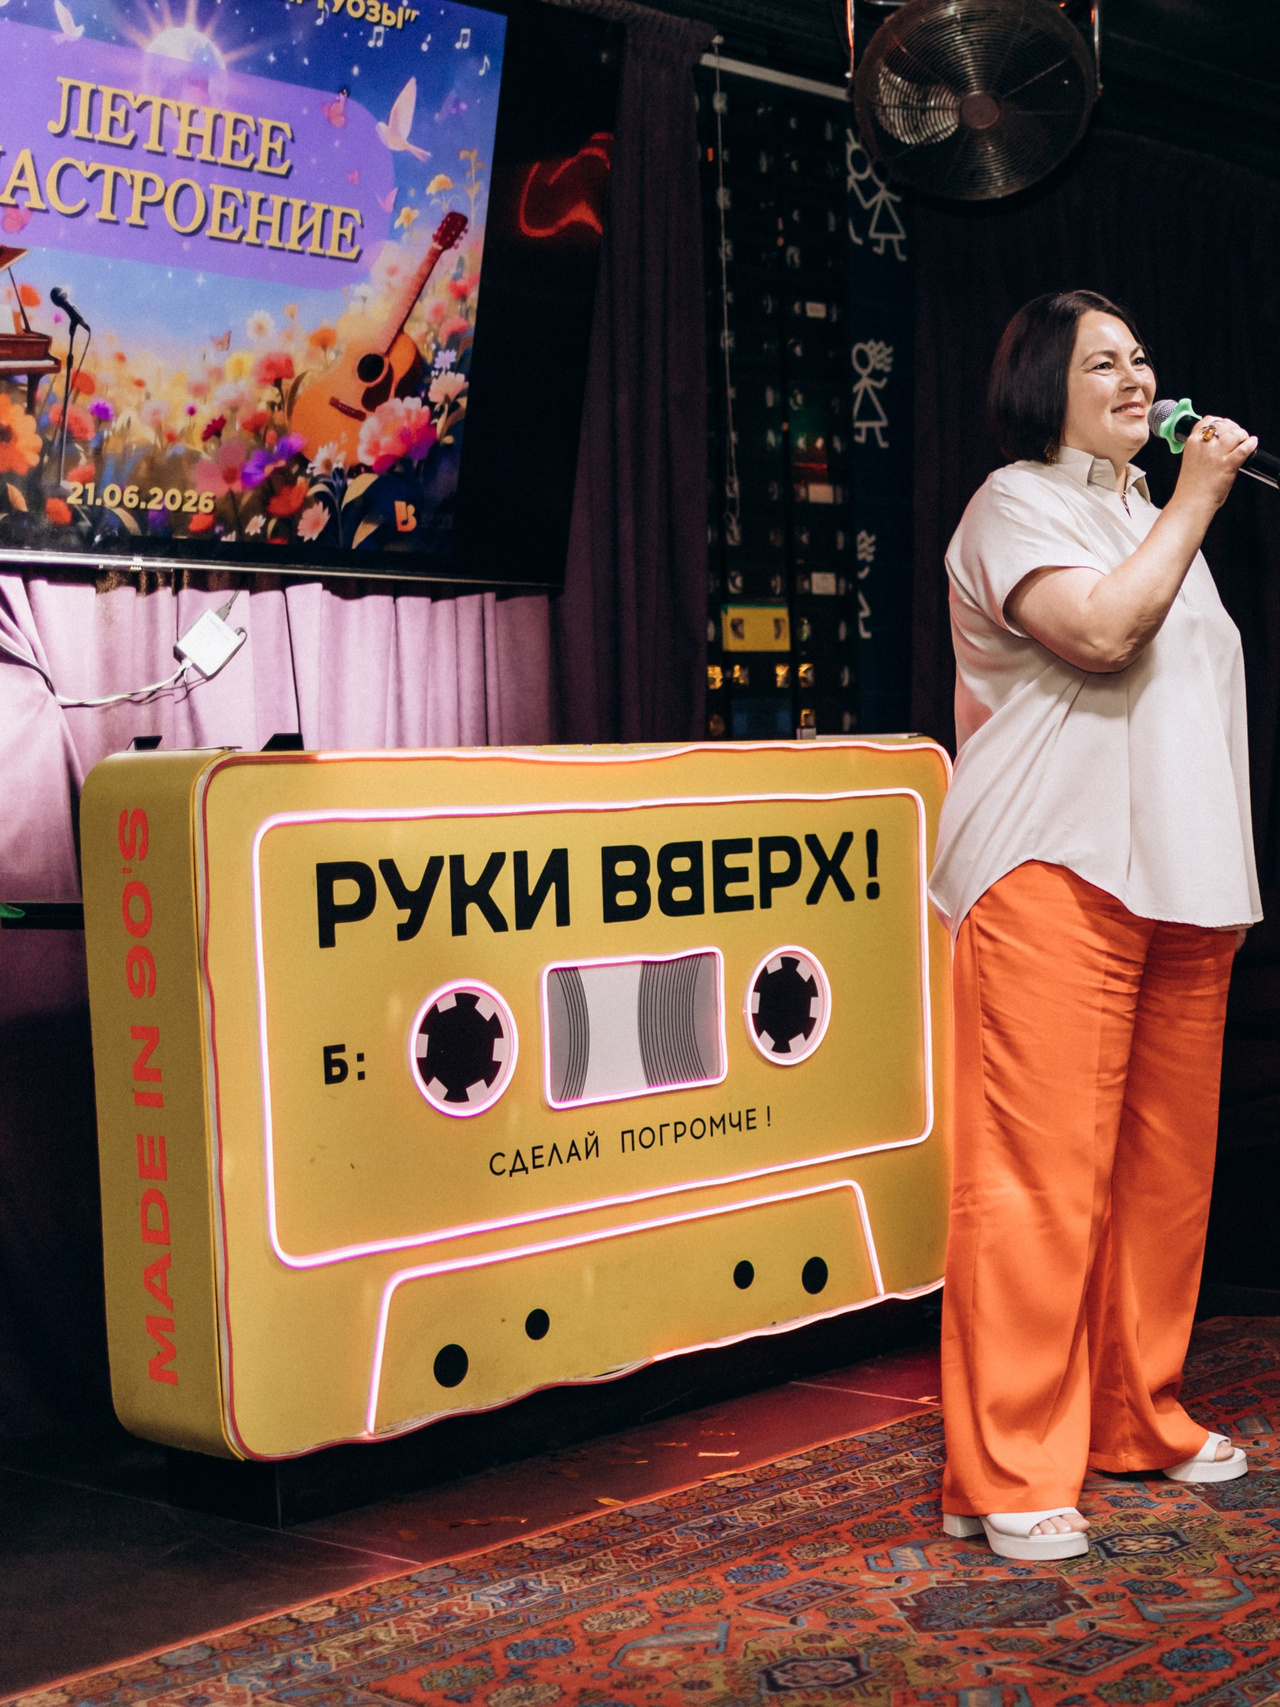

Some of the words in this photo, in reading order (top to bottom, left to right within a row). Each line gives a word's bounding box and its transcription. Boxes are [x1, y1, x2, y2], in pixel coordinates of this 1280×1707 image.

[47, 75, 294, 177] ЛЕТНЕЕ
[0, 145, 364, 261] АСТРОЕНИЕ
[66, 481, 215, 514] 21.06.2026
[118, 807, 156, 999] 90'S
[315, 847, 571, 949] РУКИ
[601, 828, 880, 924] ВВЕРХ!
[130, 1025, 164, 1108] IN
[322, 1043, 367, 1086] Б:
[488, 1130, 600, 1178] СДЕЛАЙ
[136, 1133, 178, 1386] MADE
